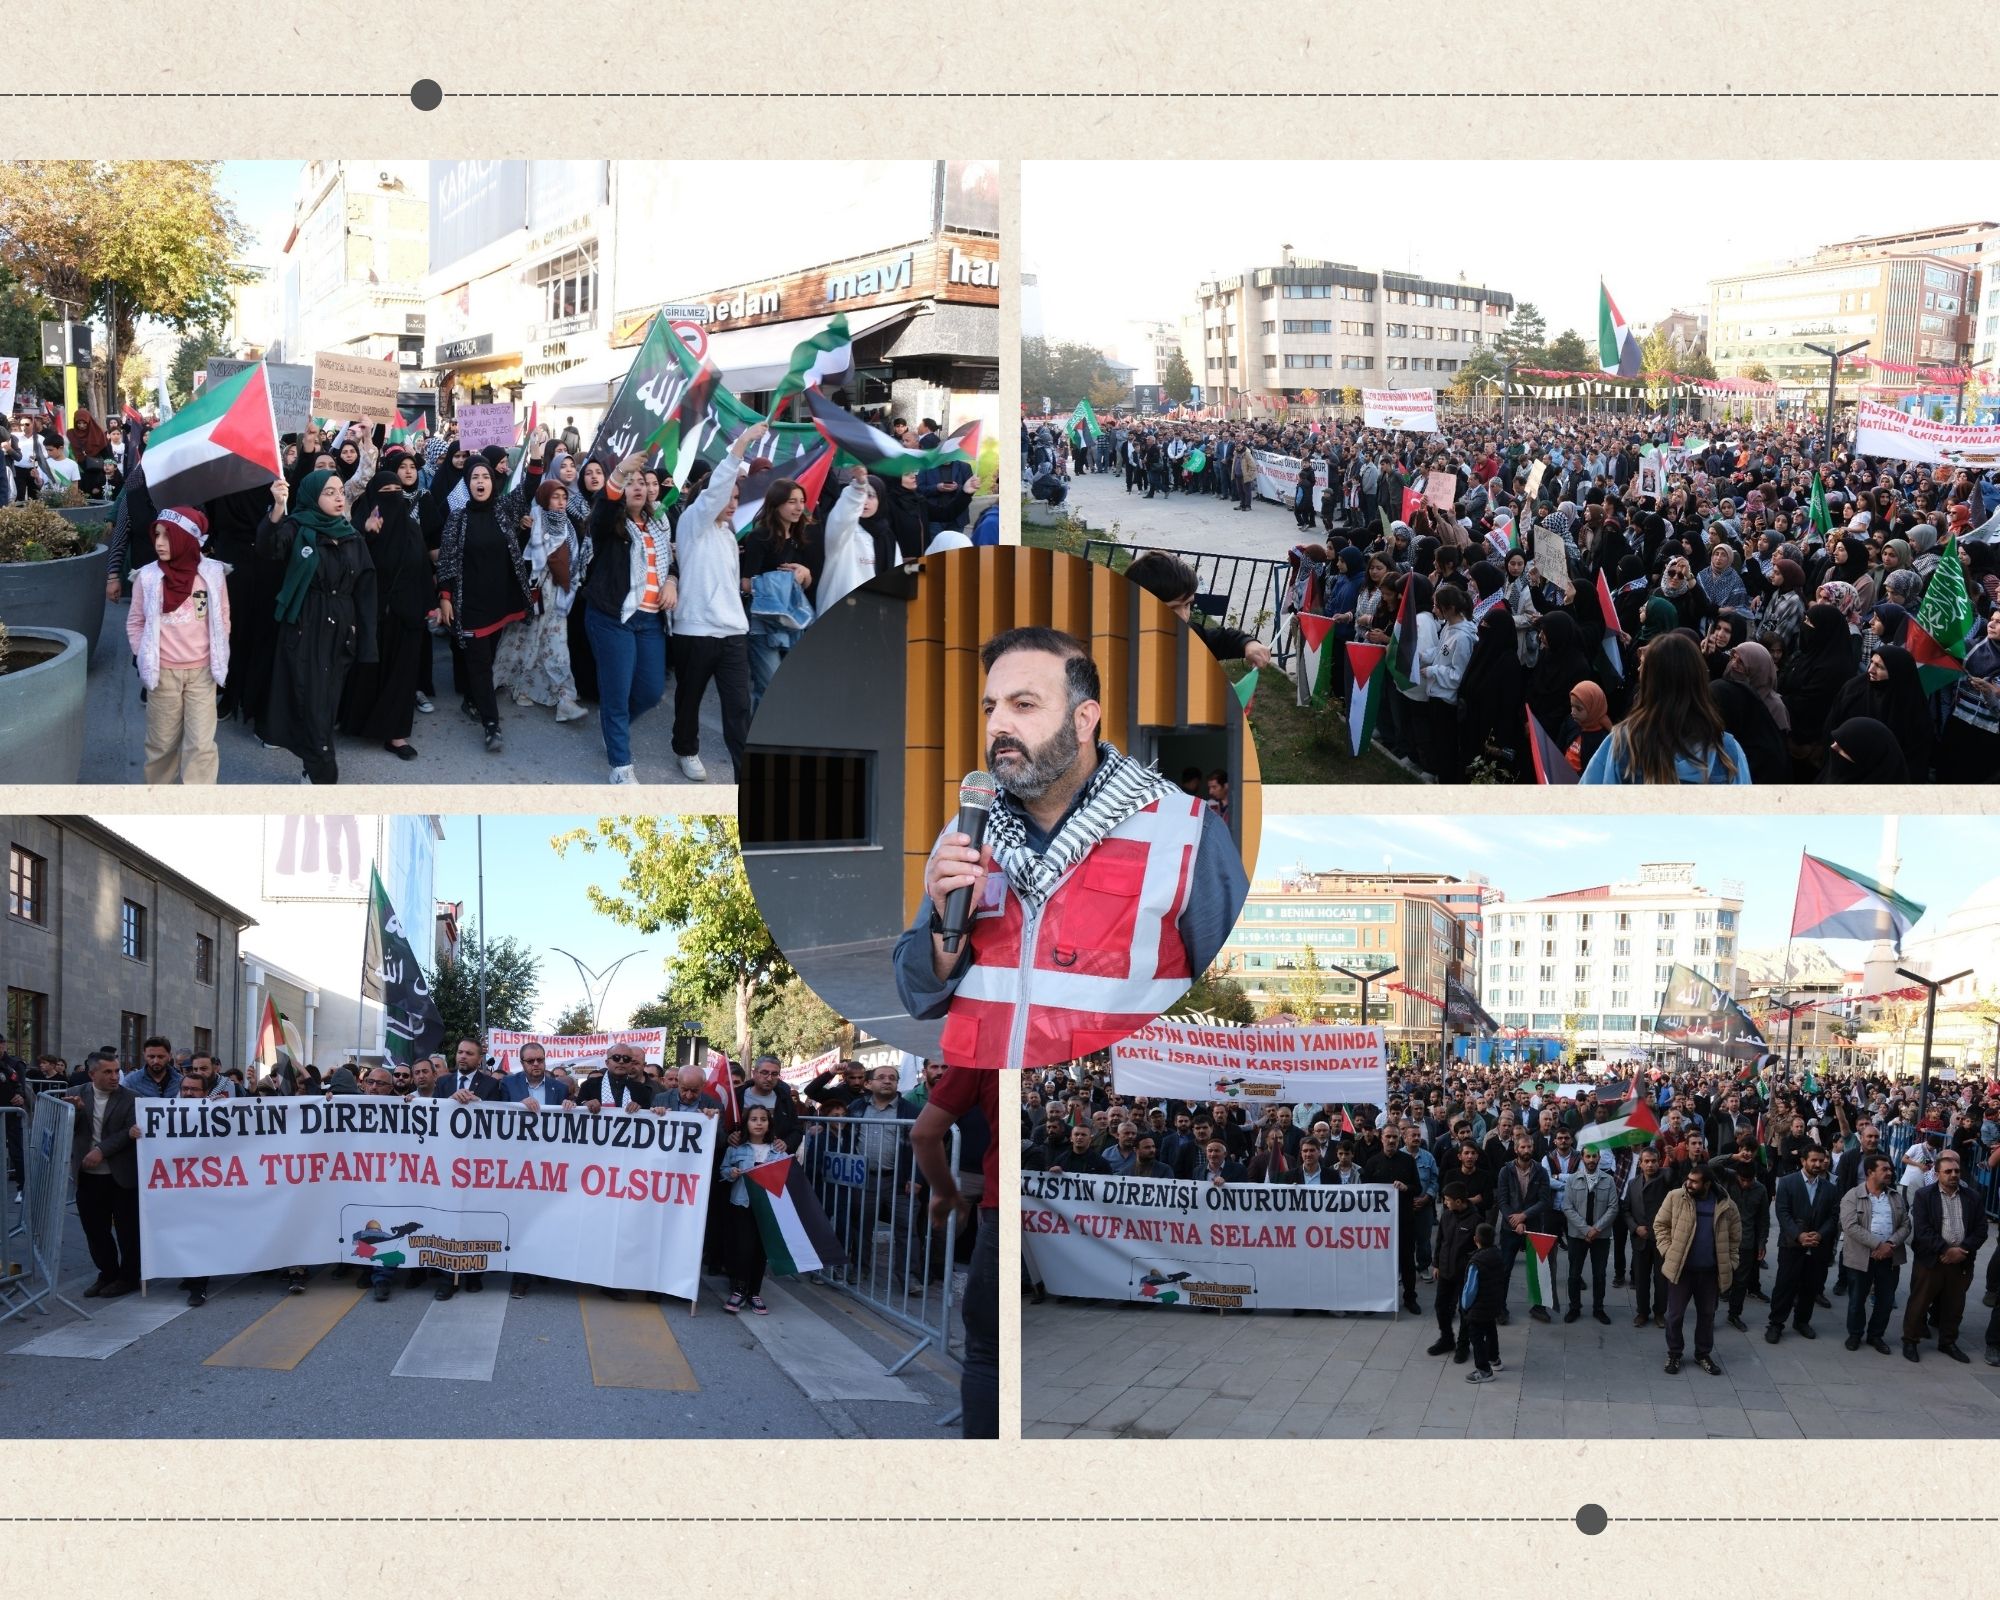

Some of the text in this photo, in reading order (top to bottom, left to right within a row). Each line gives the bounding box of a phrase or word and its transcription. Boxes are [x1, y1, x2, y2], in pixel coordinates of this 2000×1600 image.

[827, 252, 914, 302] mavi
[451, 340, 478, 358] KARACA
[1280, 907, 1357, 918] BENİM HOCAM
[611, 1031, 662, 1045] YANINDA
[1187, 1028, 1295, 1056] DİRENİŞİNİN
[1300, 1031, 1379, 1052] YANINDA
[1117, 1046, 1379, 1074] KATİL İSRAİLİN KARŞISINDAYIZ
[144, 1097, 702, 1154] FİLİSTİN DİRENİŞİ ONURUMUZDUR
[148, 1155, 249, 1189] AKSA
[451, 1157, 569, 1193] SELAM
[580, 1164, 700, 1206] OLSUN
[1021, 1172, 1391, 1215] LİSTİN DİRENİŞİ ONURUMUZDUR
[408, 1235, 427, 1249] VAN
[467, 1240, 503, 1252] DESTEK
[1210, 1223, 1297, 1248] SELAM
[1305, 1225, 1391, 1250] OLSUN
[418, 1249, 488, 1271] PLATFORMU
[1189, 1292, 1243, 1307] PLATFORMU
